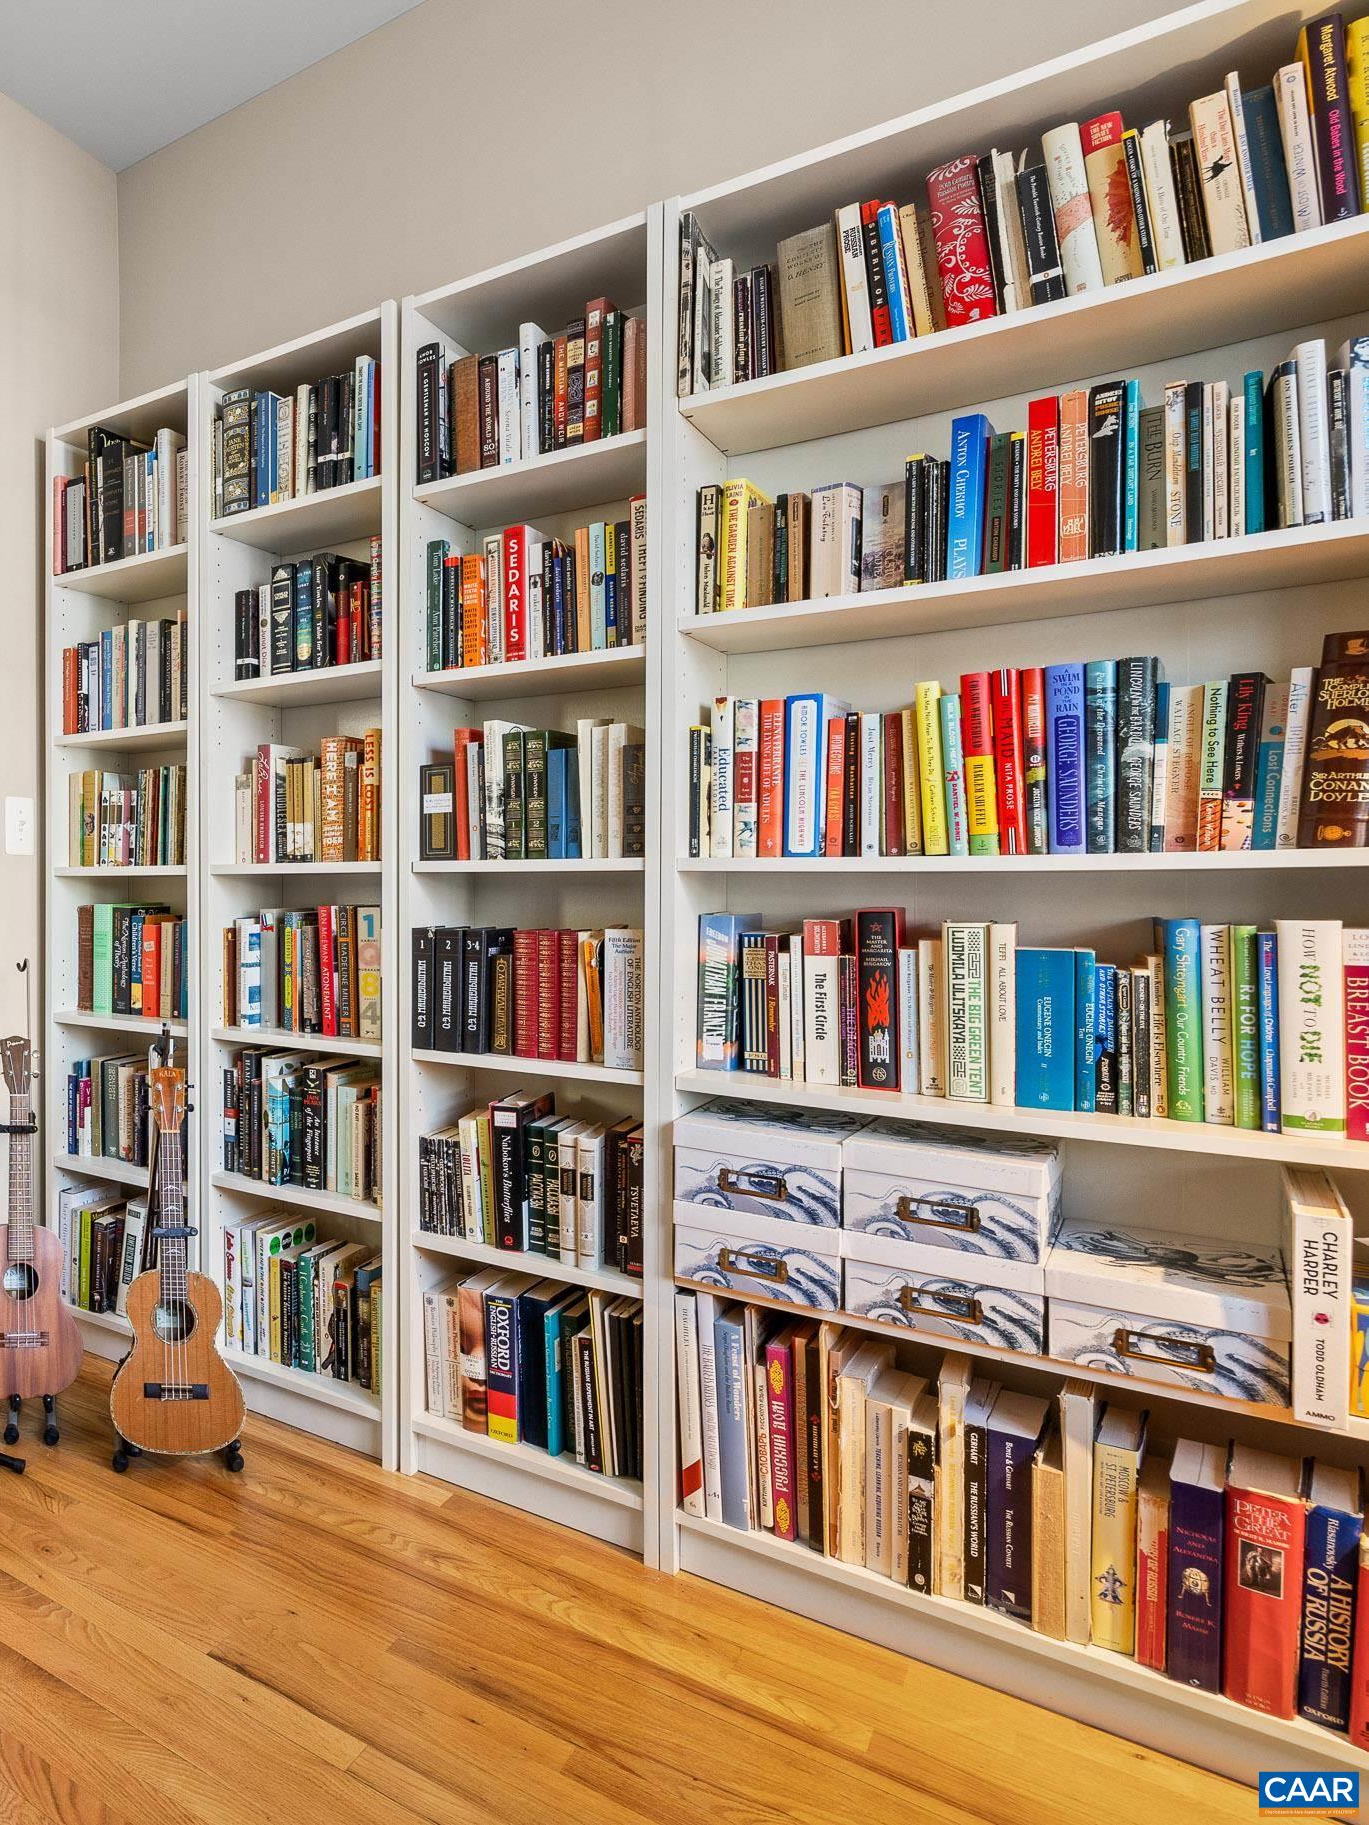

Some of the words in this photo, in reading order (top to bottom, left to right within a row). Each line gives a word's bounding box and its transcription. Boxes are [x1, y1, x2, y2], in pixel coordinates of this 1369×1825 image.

[1319, 25, 1337, 65] Margaret
[1325, 67, 1340, 101] Atwood
[1329, 109, 1340, 123] Old
[1330, 124, 1342, 148] Babes
[1333, 148, 1342, 157] in
[1334, 158, 1344, 171] the
[1335, 171, 1346, 195] Wood
[850, 227, 858, 258] RUSSIAN
[1284, 380, 1291, 393] ON
[1060, 423, 1072, 463] ANDREI
[1285, 415, 1294, 450] GOLDEN
[957, 430, 970, 466] ANTON
[1031, 430, 1042, 467] ANDREI
[1044, 428, 1056, 491] PETERSBURG
[1075, 423, 1087, 488] PETERSBURG
[1031, 470, 1042, 491] BELY
[1060, 465, 1072, 486] BELY
[1287, 454, 1296, 484] PORCH
[955, 470, 969, 519] CHEKHOV
[634, 505, 645, 539] SEDARIS
[729, 507, 739, 521] THE
[620, 533, 629, 556] david
[727, 523, 739, 553] GARDEN
[620, 558, 629, 587] sedaris
[726, 555, 738, 587] AGAINST
[952, 538, 967, 579] PLAYS
[508, 539, 520, 642] SEDARIS
[725, 589, 736, 608] TIME
[969, 680, 980, 705] COLSON
[1053, 673, 1080, 683] SWIM
[1053, 687, 1079, 696] POND
[1206, 688, 1222, 725] Nothing
[1289, 683, 1307, 714] After
[971, 707, 982, 749] WHITEHEAD
[1000, 716, 1014, 759] MAID
[1173, 700, 1183, 746] WALLACE
[1207, 728, 1220, 738] to
[365, 734, 375, 762] LESS
[831, 734, 841, 775] HOMEGOING
[1058, 719, 1078, 766] GEORGE
[1207, 740, 1220, 758] See
[326, 741, 337, 780] HERE
[365, 767, 375, 778] IS
[1171, 748, 1182, 793] STEGNER
[1206, 761, 1219, 783] Here
[1267, 750, 1281, 770] Lost
[326, 785, 337, 795] I
[718, 748, 730, 811] Educated
[830, 786, 840, 800] YAA
[973, 764, 985, 793] HARLEM
[277, 788, 287, 833] MIDDLESEX
[326, 799, 338, 820] AM
[365, 784, 375, 812] LOST
[829, 801, 840, 821] GYASI
[975, 795, 987, 827] SHUFFLE
[1006, 784, 1014, 809] PROSE
[1058, 769, 1079, 831] SAUNDERS
[1263, 772, 1280, 833] Connections
[1205, 803, 1215, 821] Kevin
[1204, 823, 1215, 845] Wilson
[121, 917, 129, 930] The
[320, 909, 328, 925] IAN
[320, 927, 329, 962] McEWAN
[1174, 927, 1189, 951] Gary
[1302, 928, 1316, 959] HOW
[340, 942, 349, 984] MADELINE
[627, 958, 634, 970] OF
[634, 957, 642, 972] THE
[951, 930, 965, 980] LUDMILA
[1210, 930, 1225, 987] WHEAT
[120, 954, 129, 988] Anthology
[815, 973, 827, 989] The
[1175, 954, 1188, 1008] Shteyngart
[1299, 964, 1323, 1007] NOT
[322, 966, 331, 1019] ATONEMENT
[634, 974, 642, 1004] NORTON
[815, 991, 827, 1012] First
[968, 979, 982, 1002] THE
[626, 1003, 634, 1049] LITERATURE
[952, 983, 966, 1044] ULITSKAYA
[968, 1004, 982, 1024] BIG
[1085, 1003, 1094, 1033] EUGENE
[1176, 1012, 1188, 1029] Our
[1211, 996, 1227, 1045] BELLY
[1304, 1008, 1319, 1027] TO
[1346, 976, 1369, 1048] BREAST
[634, 1005, 642, 1052] ANTHOLOGY
[815, 1015, 827, 1040] Circle
[968, 1026, 982, 1064] GREEN
[1085, 1034, 1094, 1065] ONEGIN
[1175, 1031, 1188, 1064] Country
[1299, 1030, 1323, 1063] DIE
[159, 1070, 177, 1078] KALA
[969, 1066, 983, 1095] TENT
[1178, 1066, 1189, 1095] Friends
[1221, 1057, 1230, 1096] WILLIAM
[1349, 1054, 1369, 1110] BOOK
[305, 1128, 314, 1162] Fingerpost
[500, 1134, 513, 1177] Nabokov's
[462, 1153, 471, 1176] LOLITA
[503, 1179, 513, 1223] Butterflies
[630, 1185, 640, 1238] TSVETAEVA
[1303, 1239, 1319, 1296] HARPER
[1322, 1231, 1338, 1299] CHARLEY
[300, 1314, 309, 1334] Castle
[497, 1306, 510, 1371] OXFORD
[731, 1332, 740, 1340] A
[731, 1342, 741, 1368] Feast
[1316, 1338, 1325, 1363] TODD
[732, 1370, 742, 1379] of
[1315, 1365, 1325, 1401] OLDHAM
[732, 1382, 743, 1421] Wonders
[772, 1400, 788, 1430] ДОМ
[1305, 1410, 1335, 1421] AMMO
[773, 1434, 790, 1492] РУССКИЙ
[970, 1432, 979, 1464] GERHART
[970, 1481, 979, 1498] THE
[1118, 1464, 1130, 1497] MOSCOW
[970, 1498, 979, 1531] RUSSIAN'S
[1233, 1498, 1292, 1526] PETER
[1233, 1515, 1291, 1541] GREAT
[970, 1531, 979, 1557] WORLD
[1307, 1567, 1328, 1596] OF
[1331, 1574, 1352, 1590] A
[1304, 1600, 1328, 1662] RUSSIA
[1328, 1591, 1352, 1673] HISTORY
[1304, 1705, 1345, 1725] OXFORD
